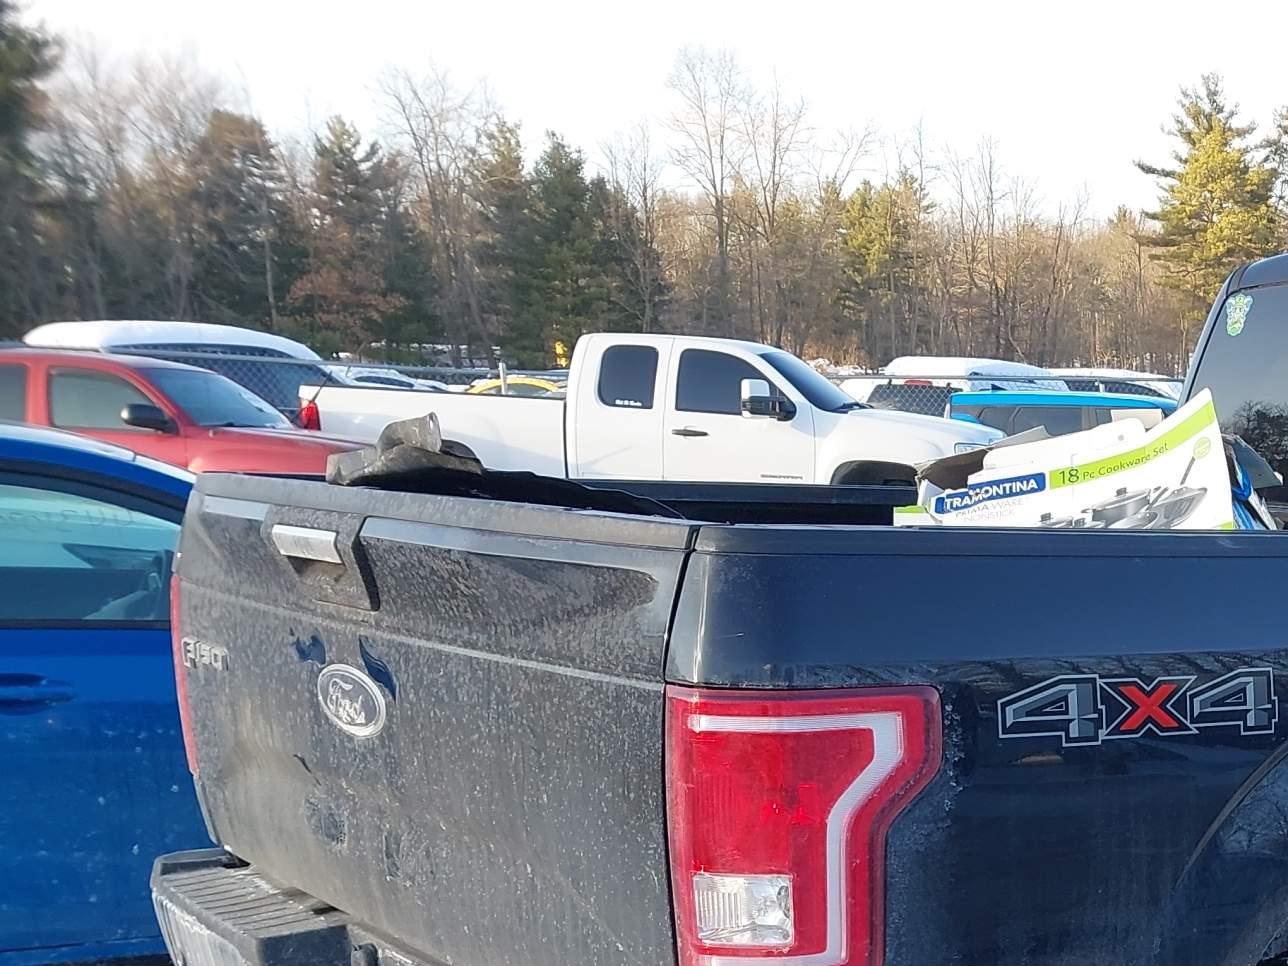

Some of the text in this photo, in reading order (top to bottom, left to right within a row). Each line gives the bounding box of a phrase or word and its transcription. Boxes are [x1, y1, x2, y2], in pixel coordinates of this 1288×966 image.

[1058, 441, 1169, 486] 18 Pc Cookware Set
[944, 477, 1039, 512] TRAMONTINA
